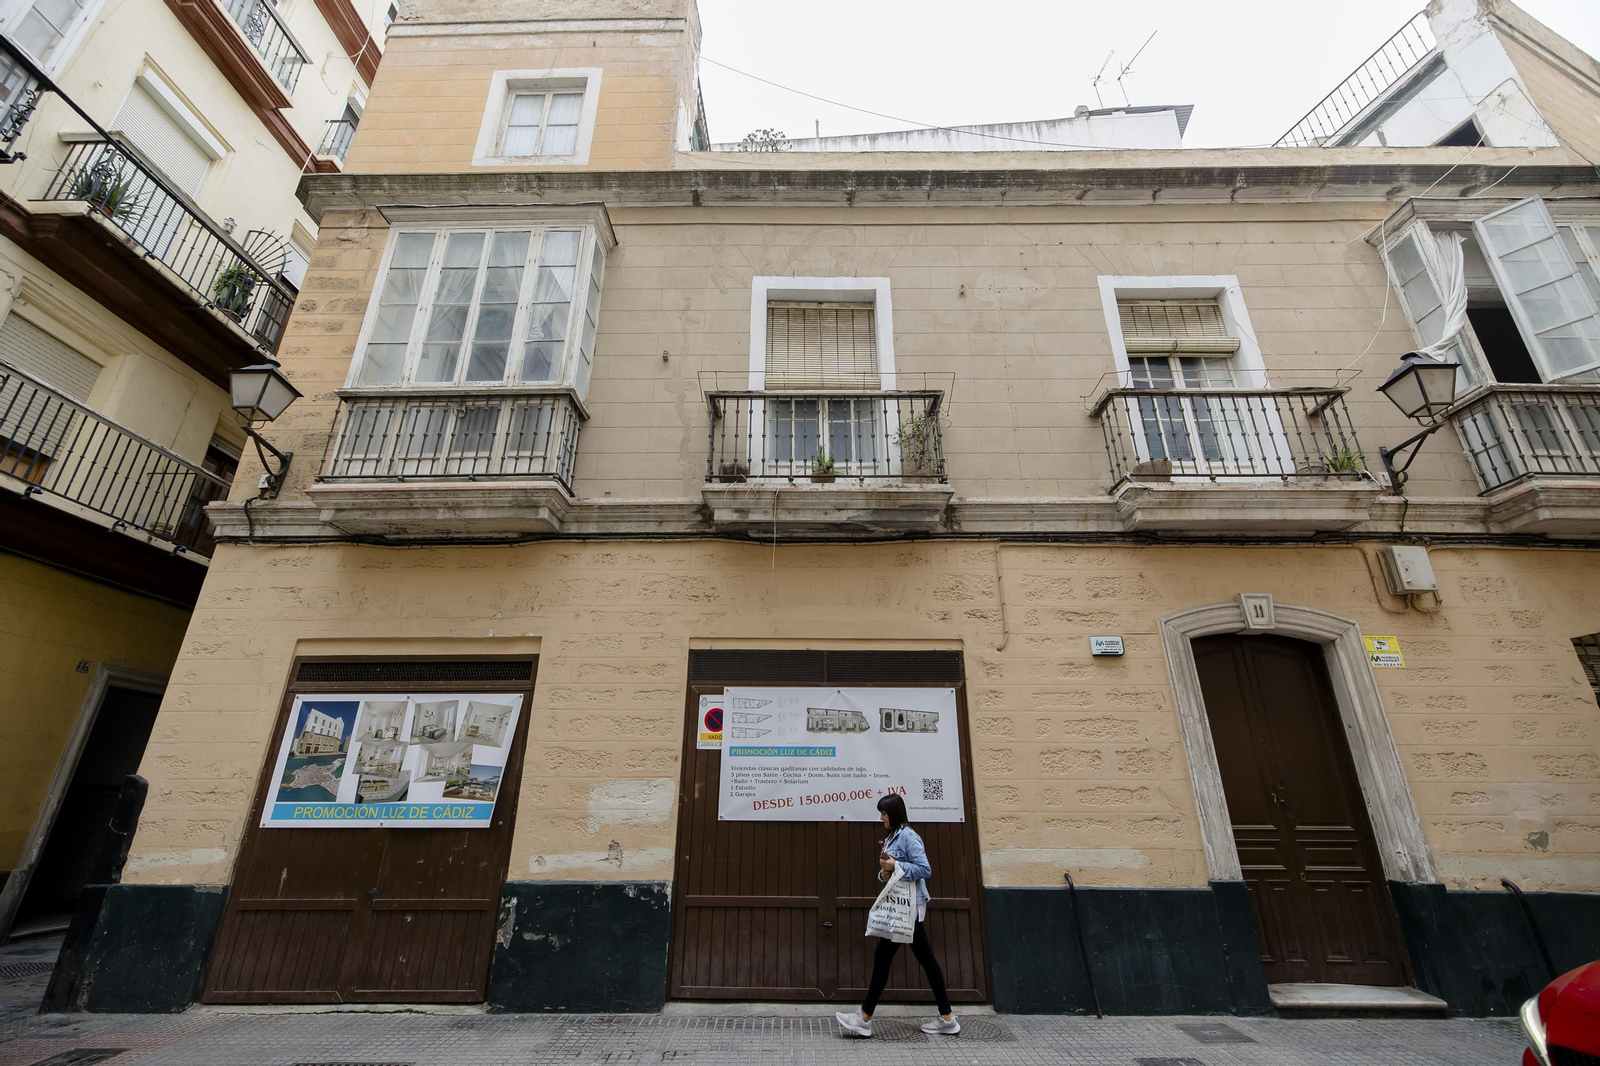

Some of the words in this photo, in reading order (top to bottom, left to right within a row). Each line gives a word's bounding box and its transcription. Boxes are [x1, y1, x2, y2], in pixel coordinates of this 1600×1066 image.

[1254, 604, 1264, 618] 11
[753, 798, 794, 810] DESDE
[799, 789, 873, 805] 150.000,00€
[887, 786, 907, 796] IVA
[293, 804, 378, 819] PROMOCIÓN
[382, 806, 406, 818] LUZ
[409, 807, 429, 818] DE
[432, 804, 474, 819] CÁDIZ
